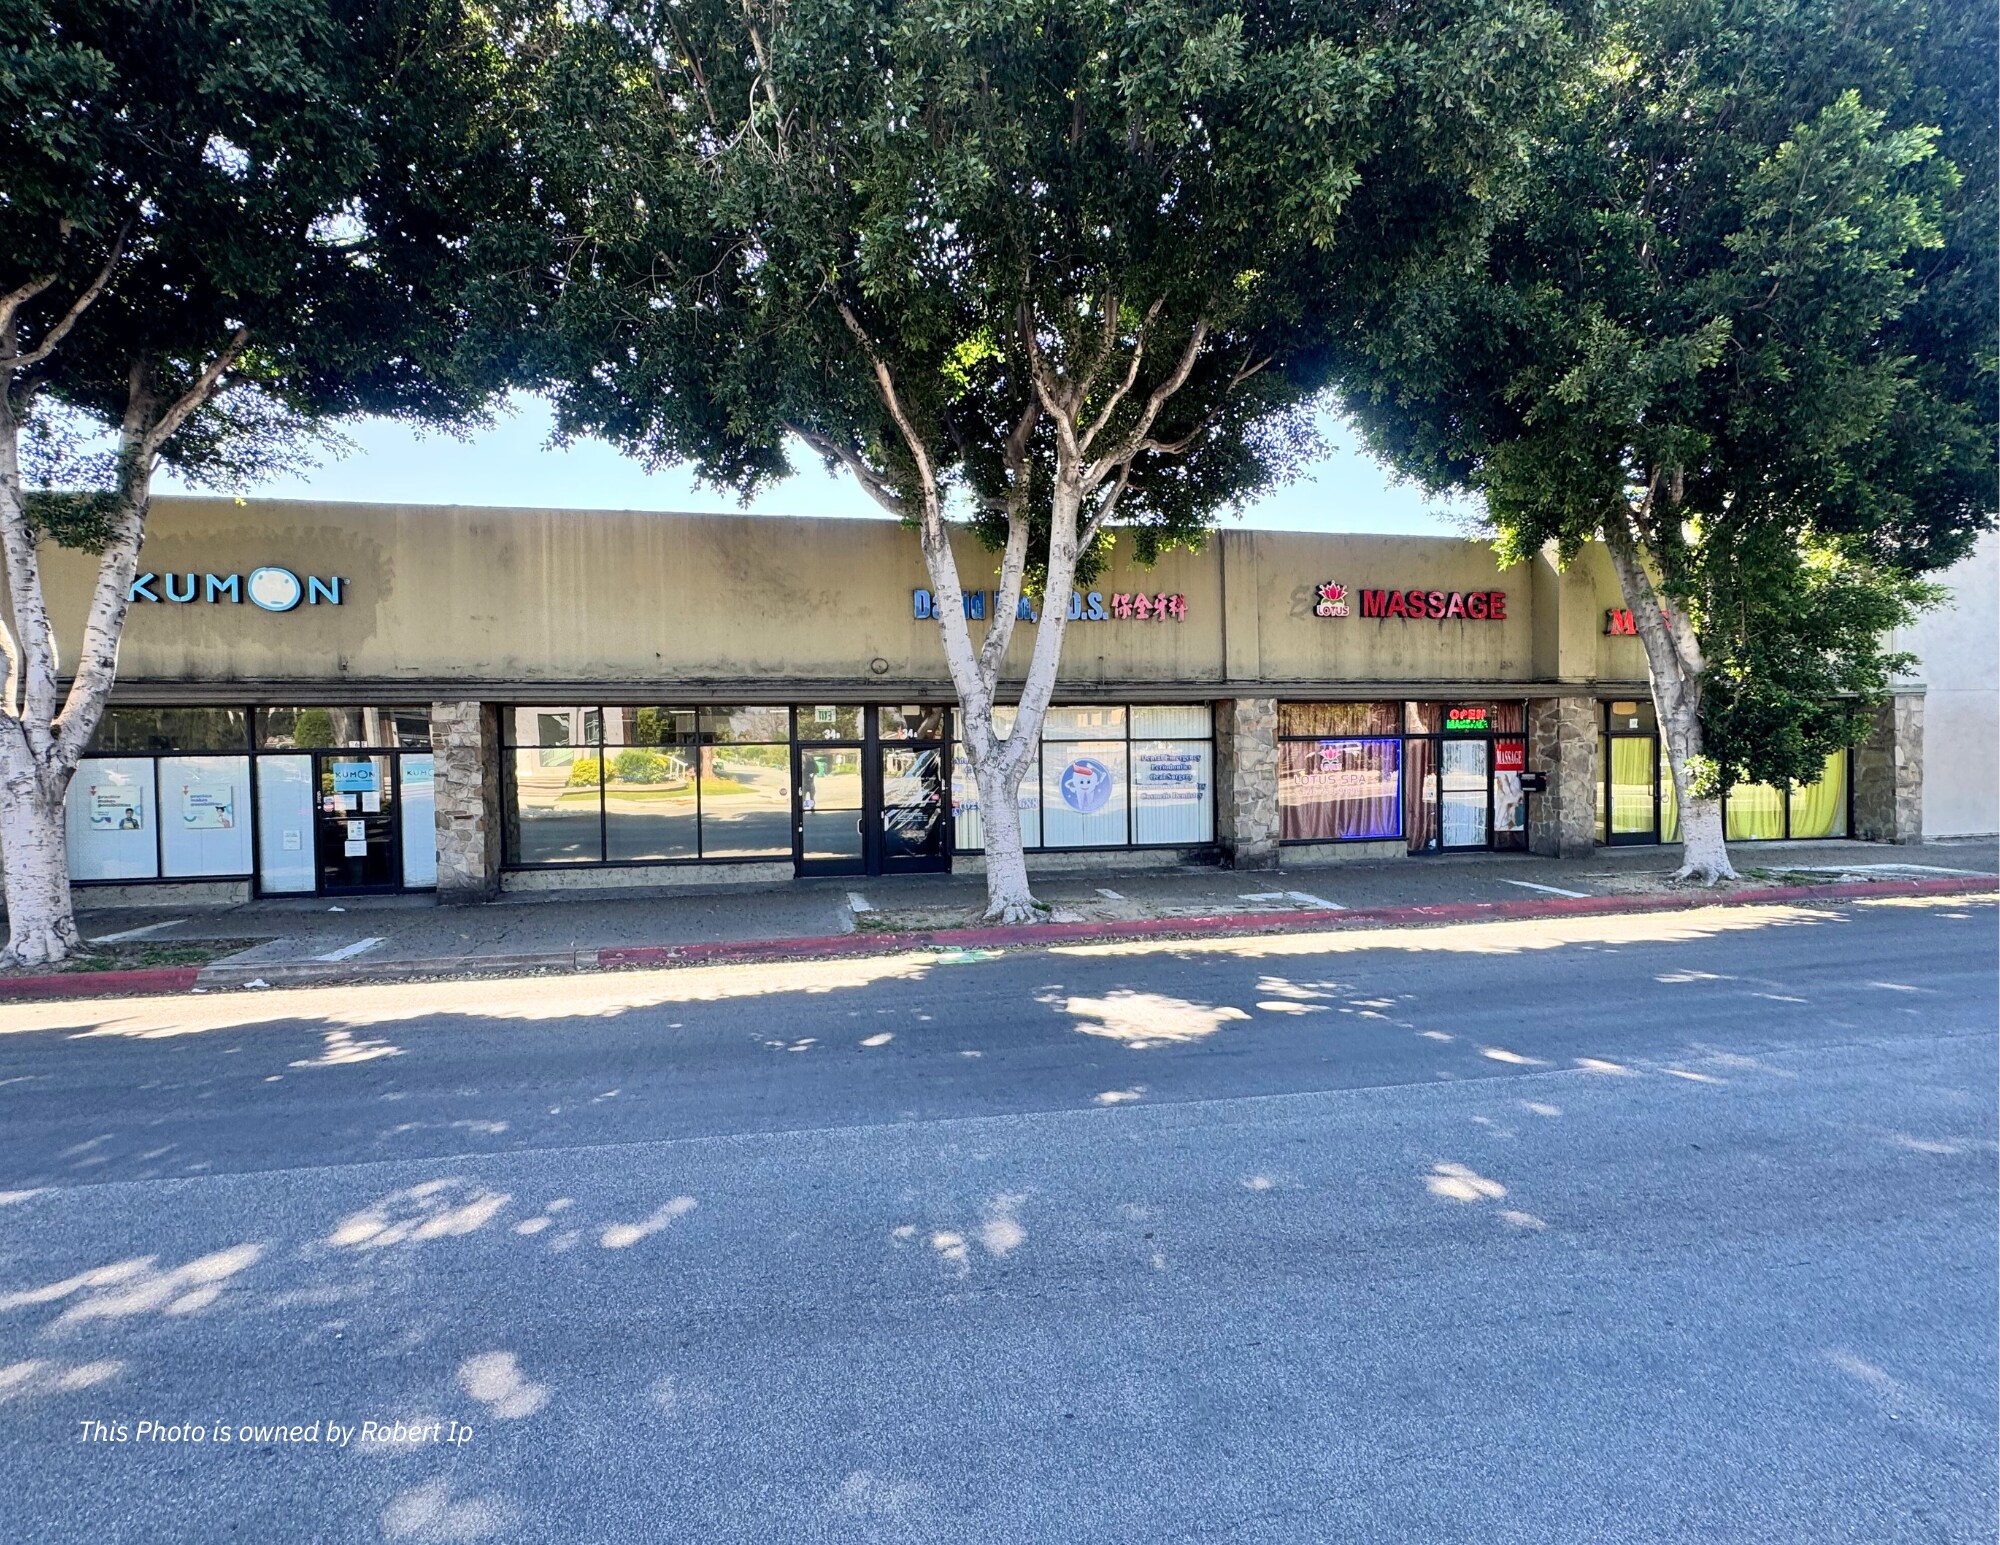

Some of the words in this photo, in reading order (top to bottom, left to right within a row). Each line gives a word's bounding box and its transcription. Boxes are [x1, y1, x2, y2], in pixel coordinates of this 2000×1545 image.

[128, 567, 340, 612] KUMON
[1111, 592, 1189, 622] 保全牙科
[1315, 604, 1350, 617] LOTUS
[1362, 589, 1507, 619] MASSAGE
[1449, 708, 1487, 720] OPEN
[1496, 750, 1522, 764] MASSAGE
[335, 769, 375, 780] KUMON
[1294, 774, 1336, 785] LOTUS
[1341, 774, 1366, 785] SPA
